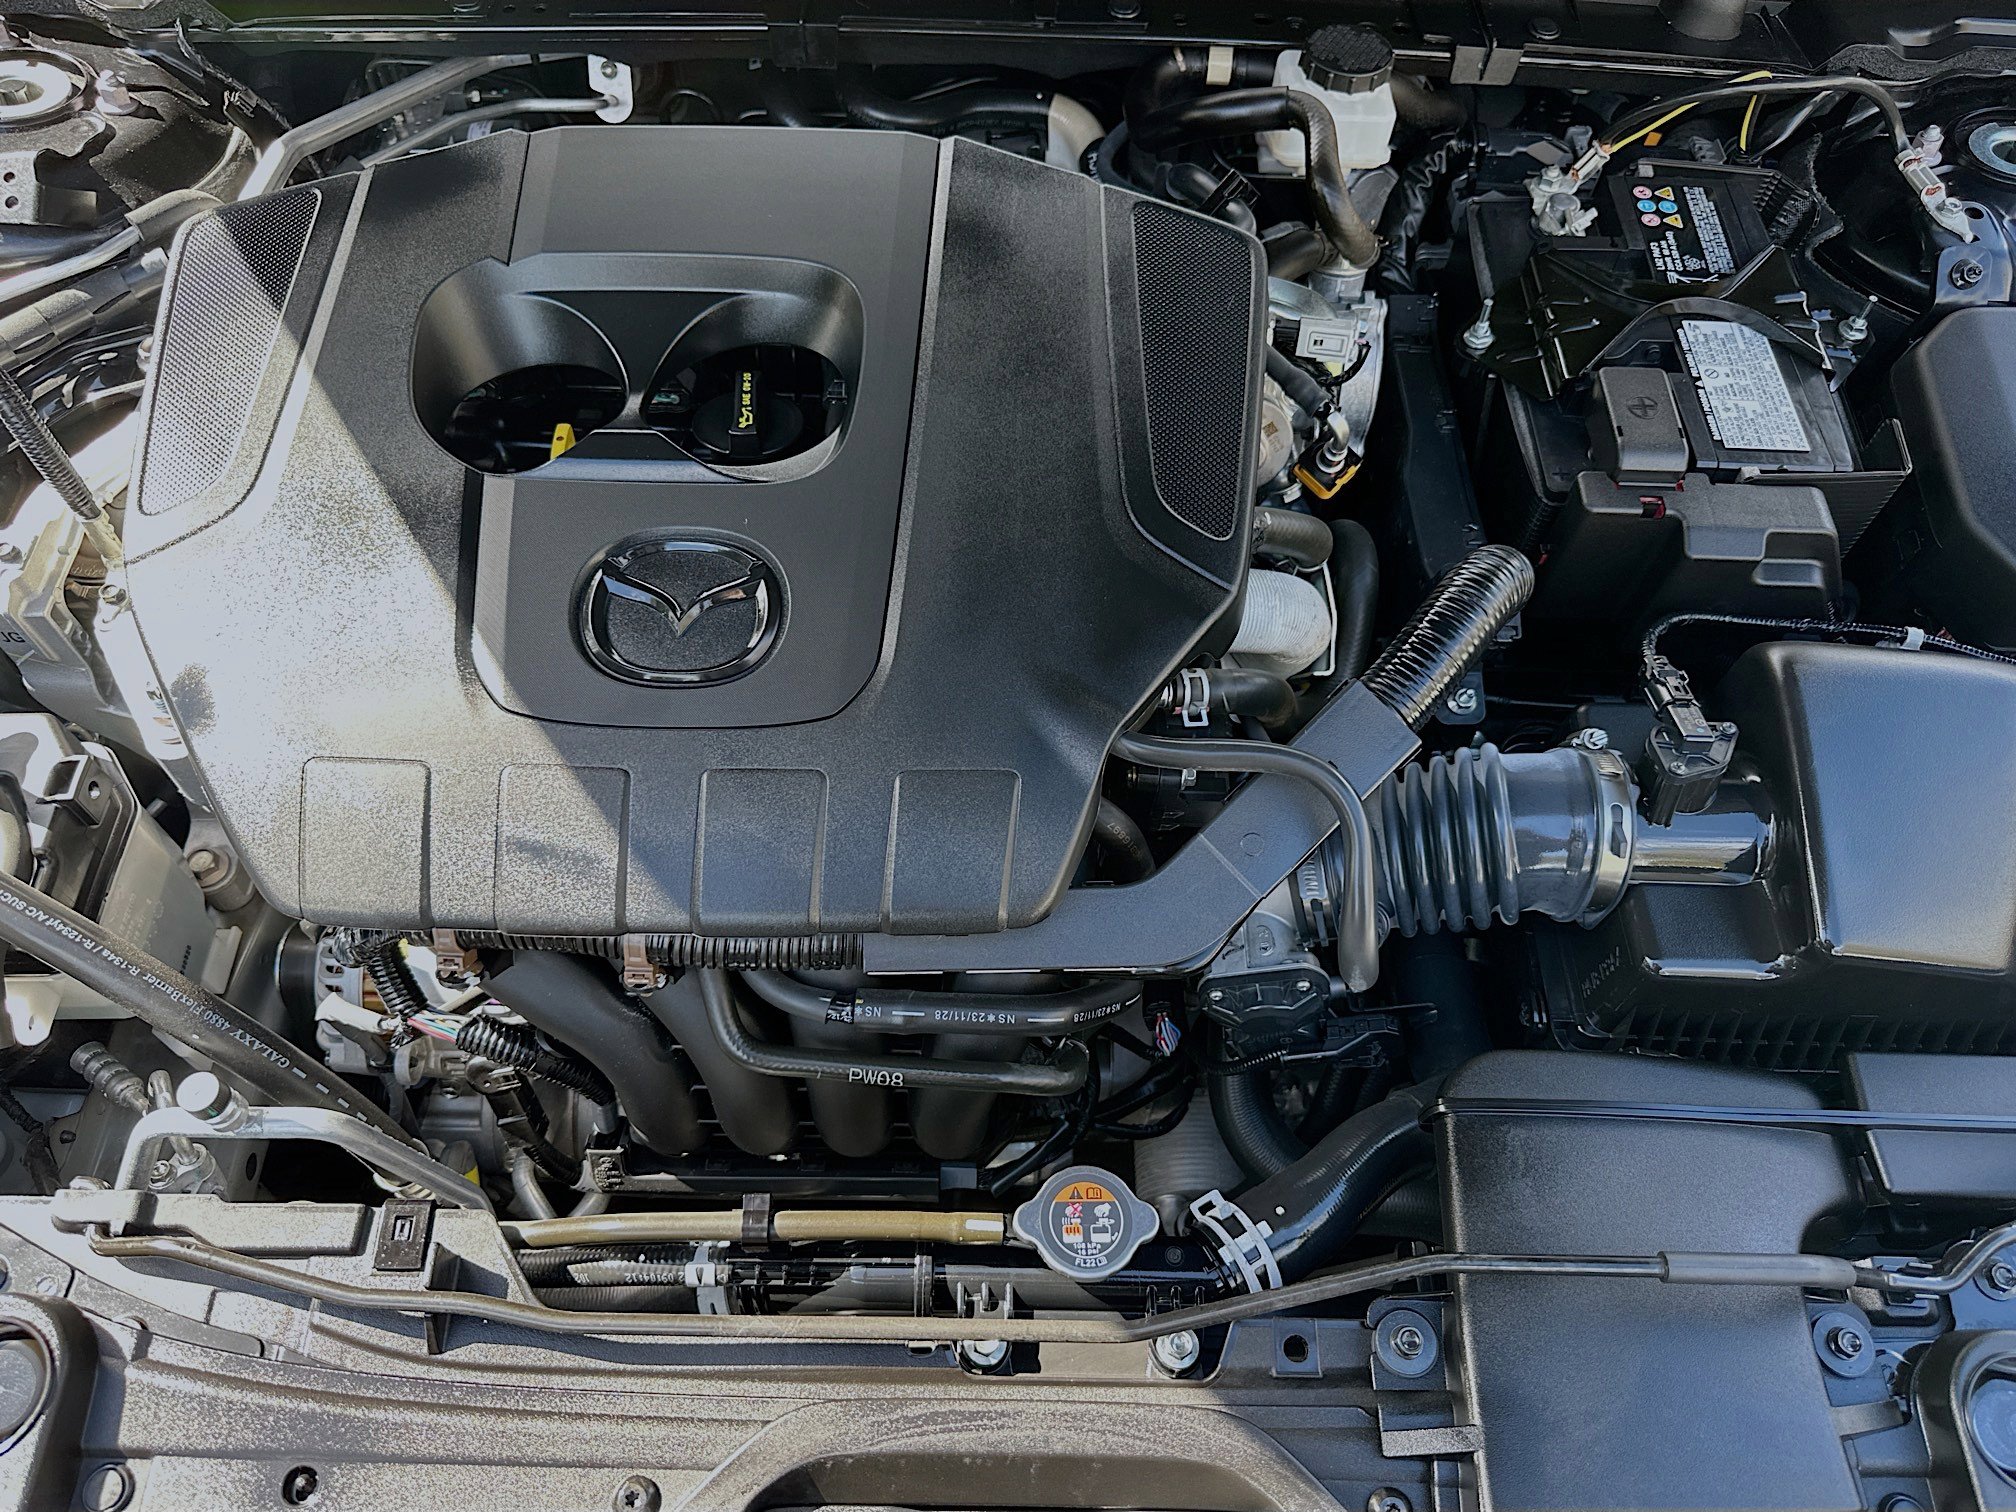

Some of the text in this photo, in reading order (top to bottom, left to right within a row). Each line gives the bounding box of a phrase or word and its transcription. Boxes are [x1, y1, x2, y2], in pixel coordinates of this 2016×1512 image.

[0, 890, 27, 910] SUC
[25, 906, 49, 922] A/C
[45, 918, 96, 950] R-1234yf
[102, 949, 140, 976] R-134a
[143, 973, 205, 1015] FlexBarrier
[204, 1010, 231, 1031] 4880
[229, 1029, 290, 1068] GALAXY
[848, 1068, 904, 1087] PW08
[1075, 1257, 1096, 1267] FL22
